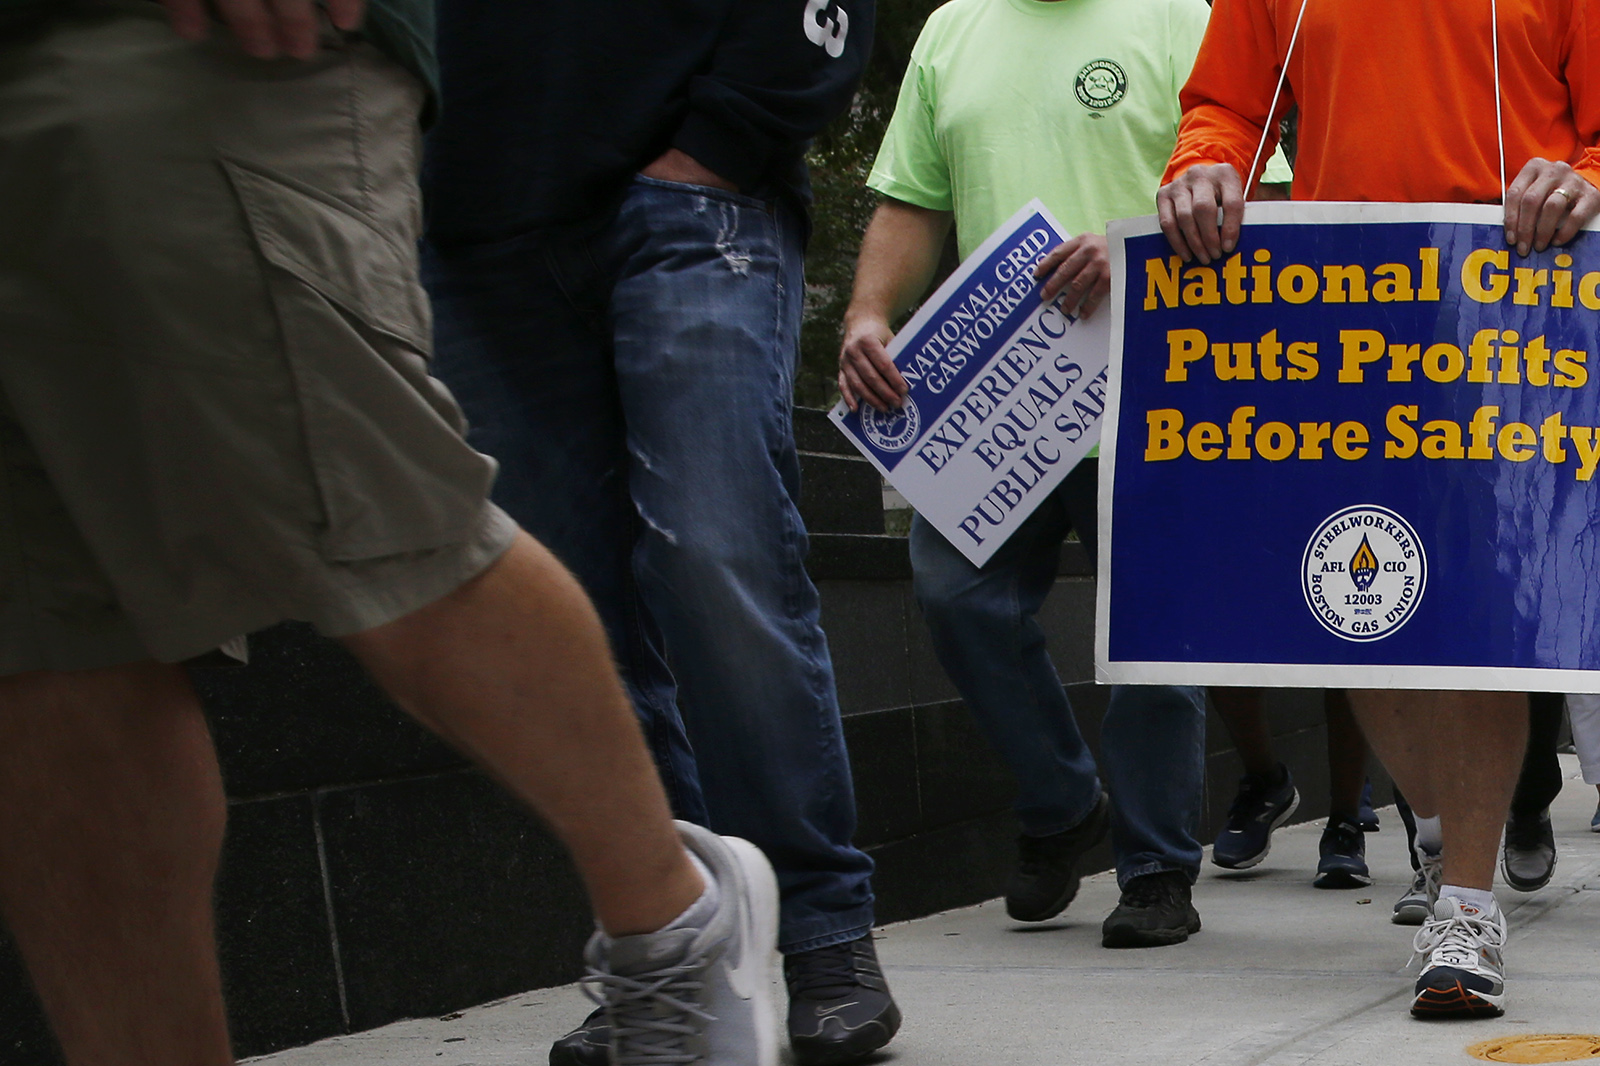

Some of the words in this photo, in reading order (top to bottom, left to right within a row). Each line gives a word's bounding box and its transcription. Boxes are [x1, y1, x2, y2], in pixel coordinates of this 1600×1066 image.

[995, 228, 1050, 285] GRID
[1143, 247, 1440, 311] National
[1165, 328, 1320, 383] Puts
[1338, 328, 1589, 388] Profits
[972, 353, 1083, 471] EQUALS
[1143, 406, 1370, 462] Before
[957, 437, 1061, 547] PUBLIC
[1314, 515, 1415, 560] STEELWORKERS
[1320, 562, 1346, 573] AFL
[1383, 561, 1407, 573] CIO
[1312, 573, 1346, 628] BOSTON
[1351, 620, 1379, 633] GAS
[1384, 575, 1415, 624] UNION
[1344, 594, 1383, 605] 12003
